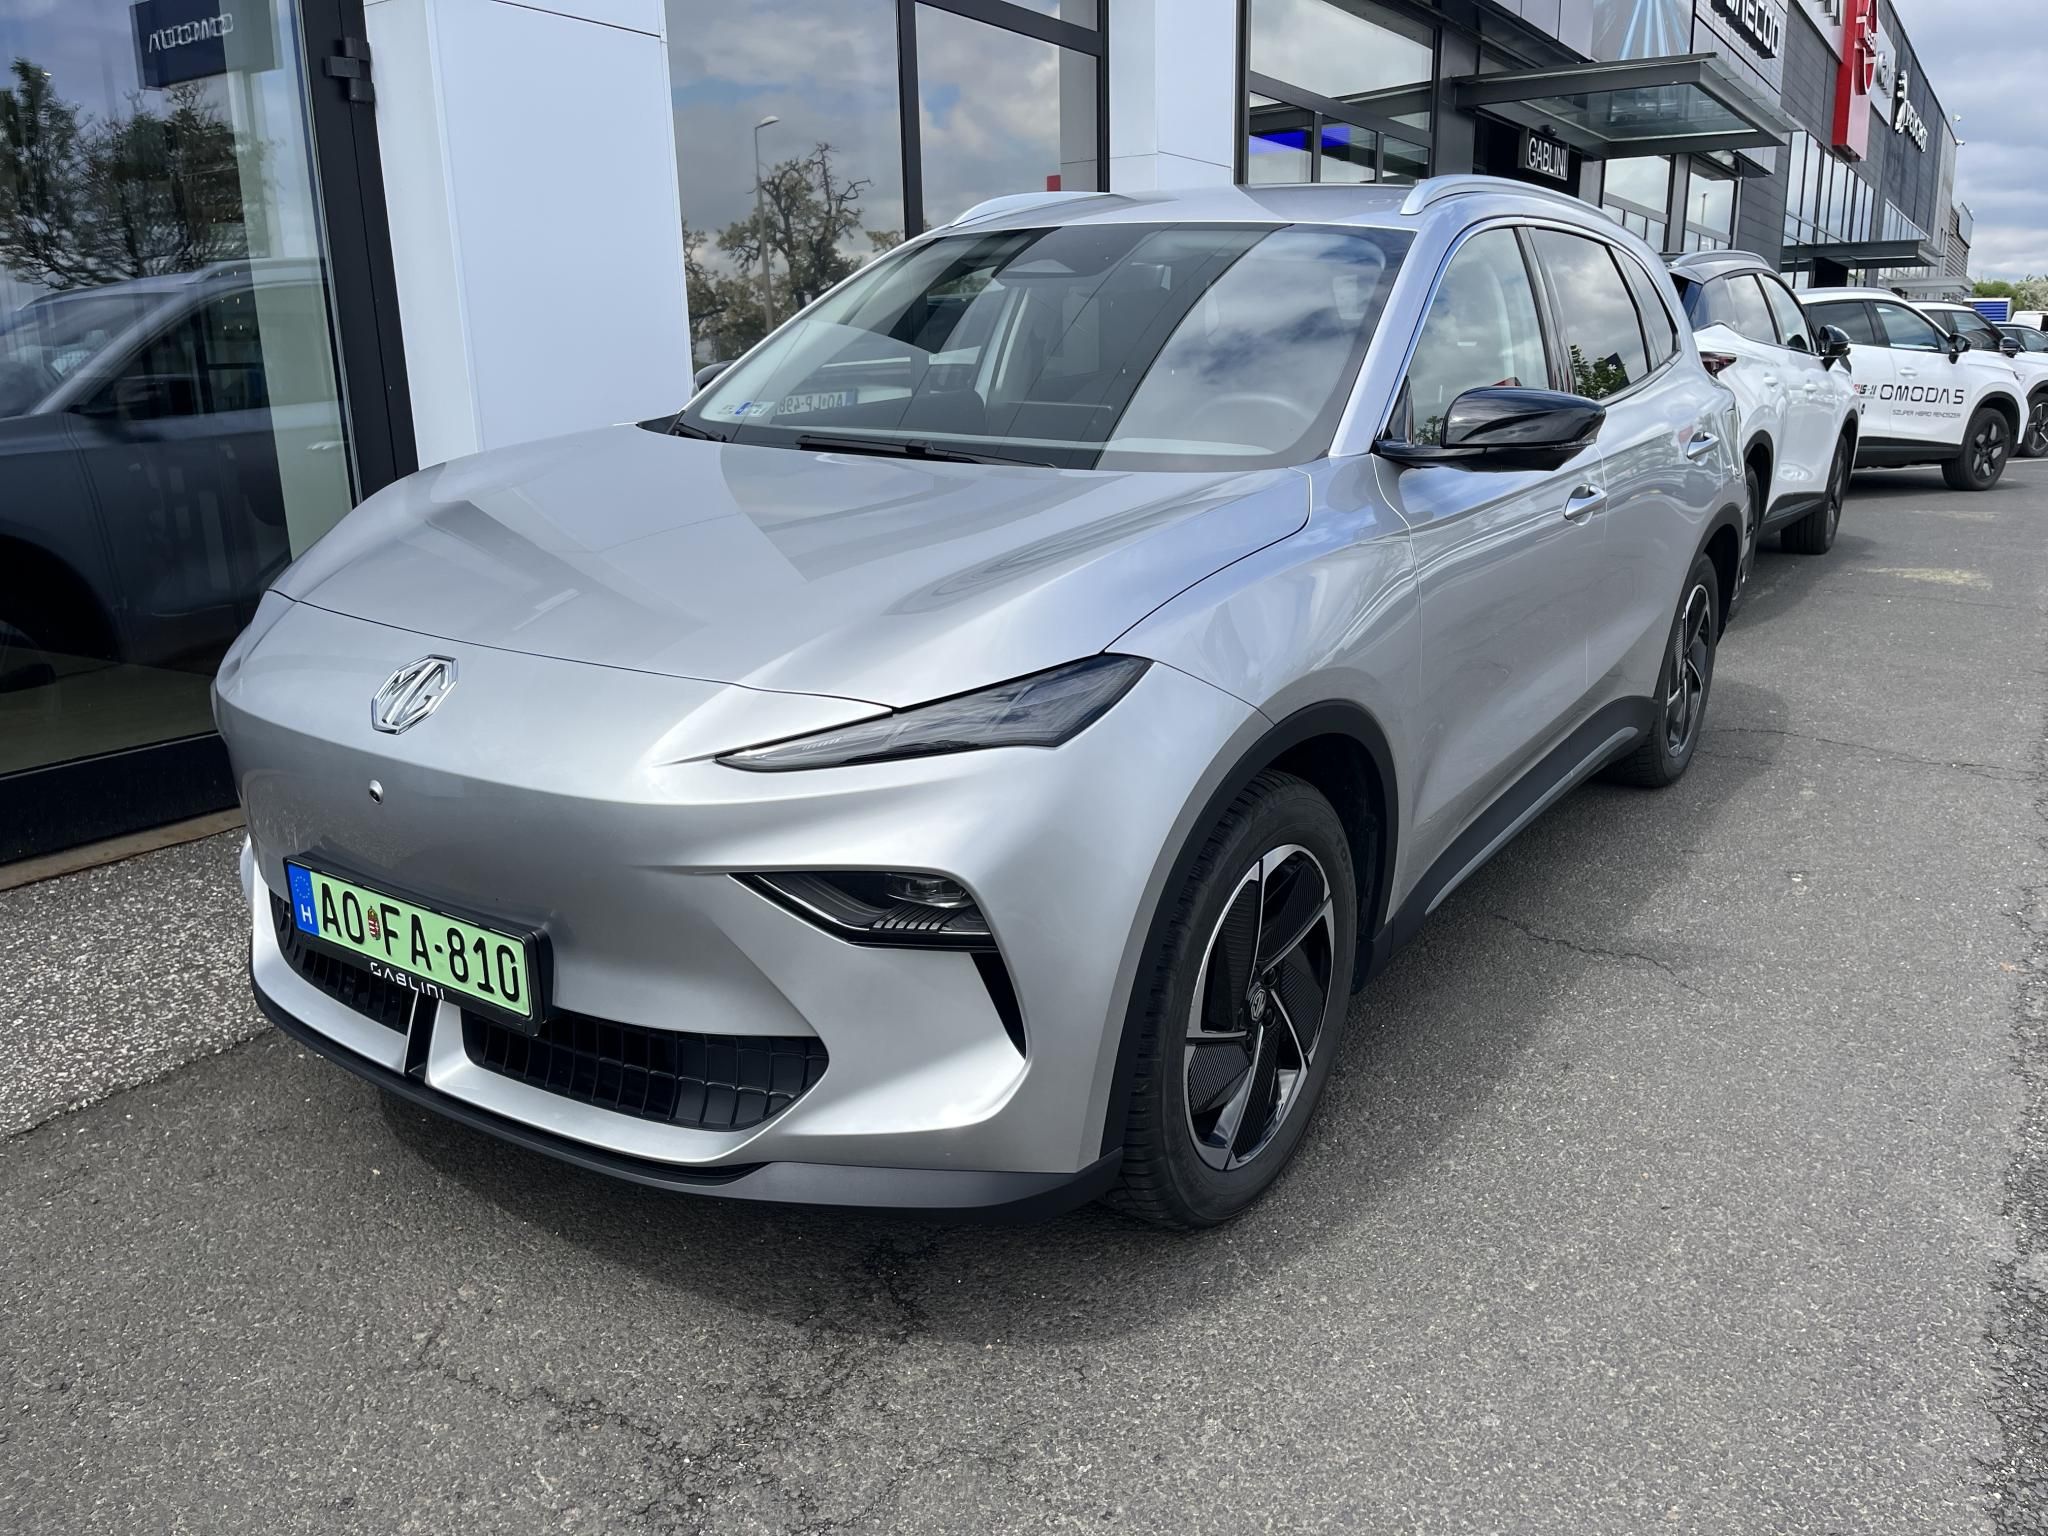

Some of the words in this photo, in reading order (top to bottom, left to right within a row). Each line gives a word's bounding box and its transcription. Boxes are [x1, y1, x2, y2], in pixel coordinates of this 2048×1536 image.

[1726, 0, 1780, 57] ECOO
[1529, 137, 1567, 177] GABLINI
[1880, 384, 1949, 404] OMODA
[1953, 389, 1964, 404] 5
[379, 660, 449, 727] MG
[301, 903, 313, 925] H
[370, 962, 445, 1000] GABLINI
